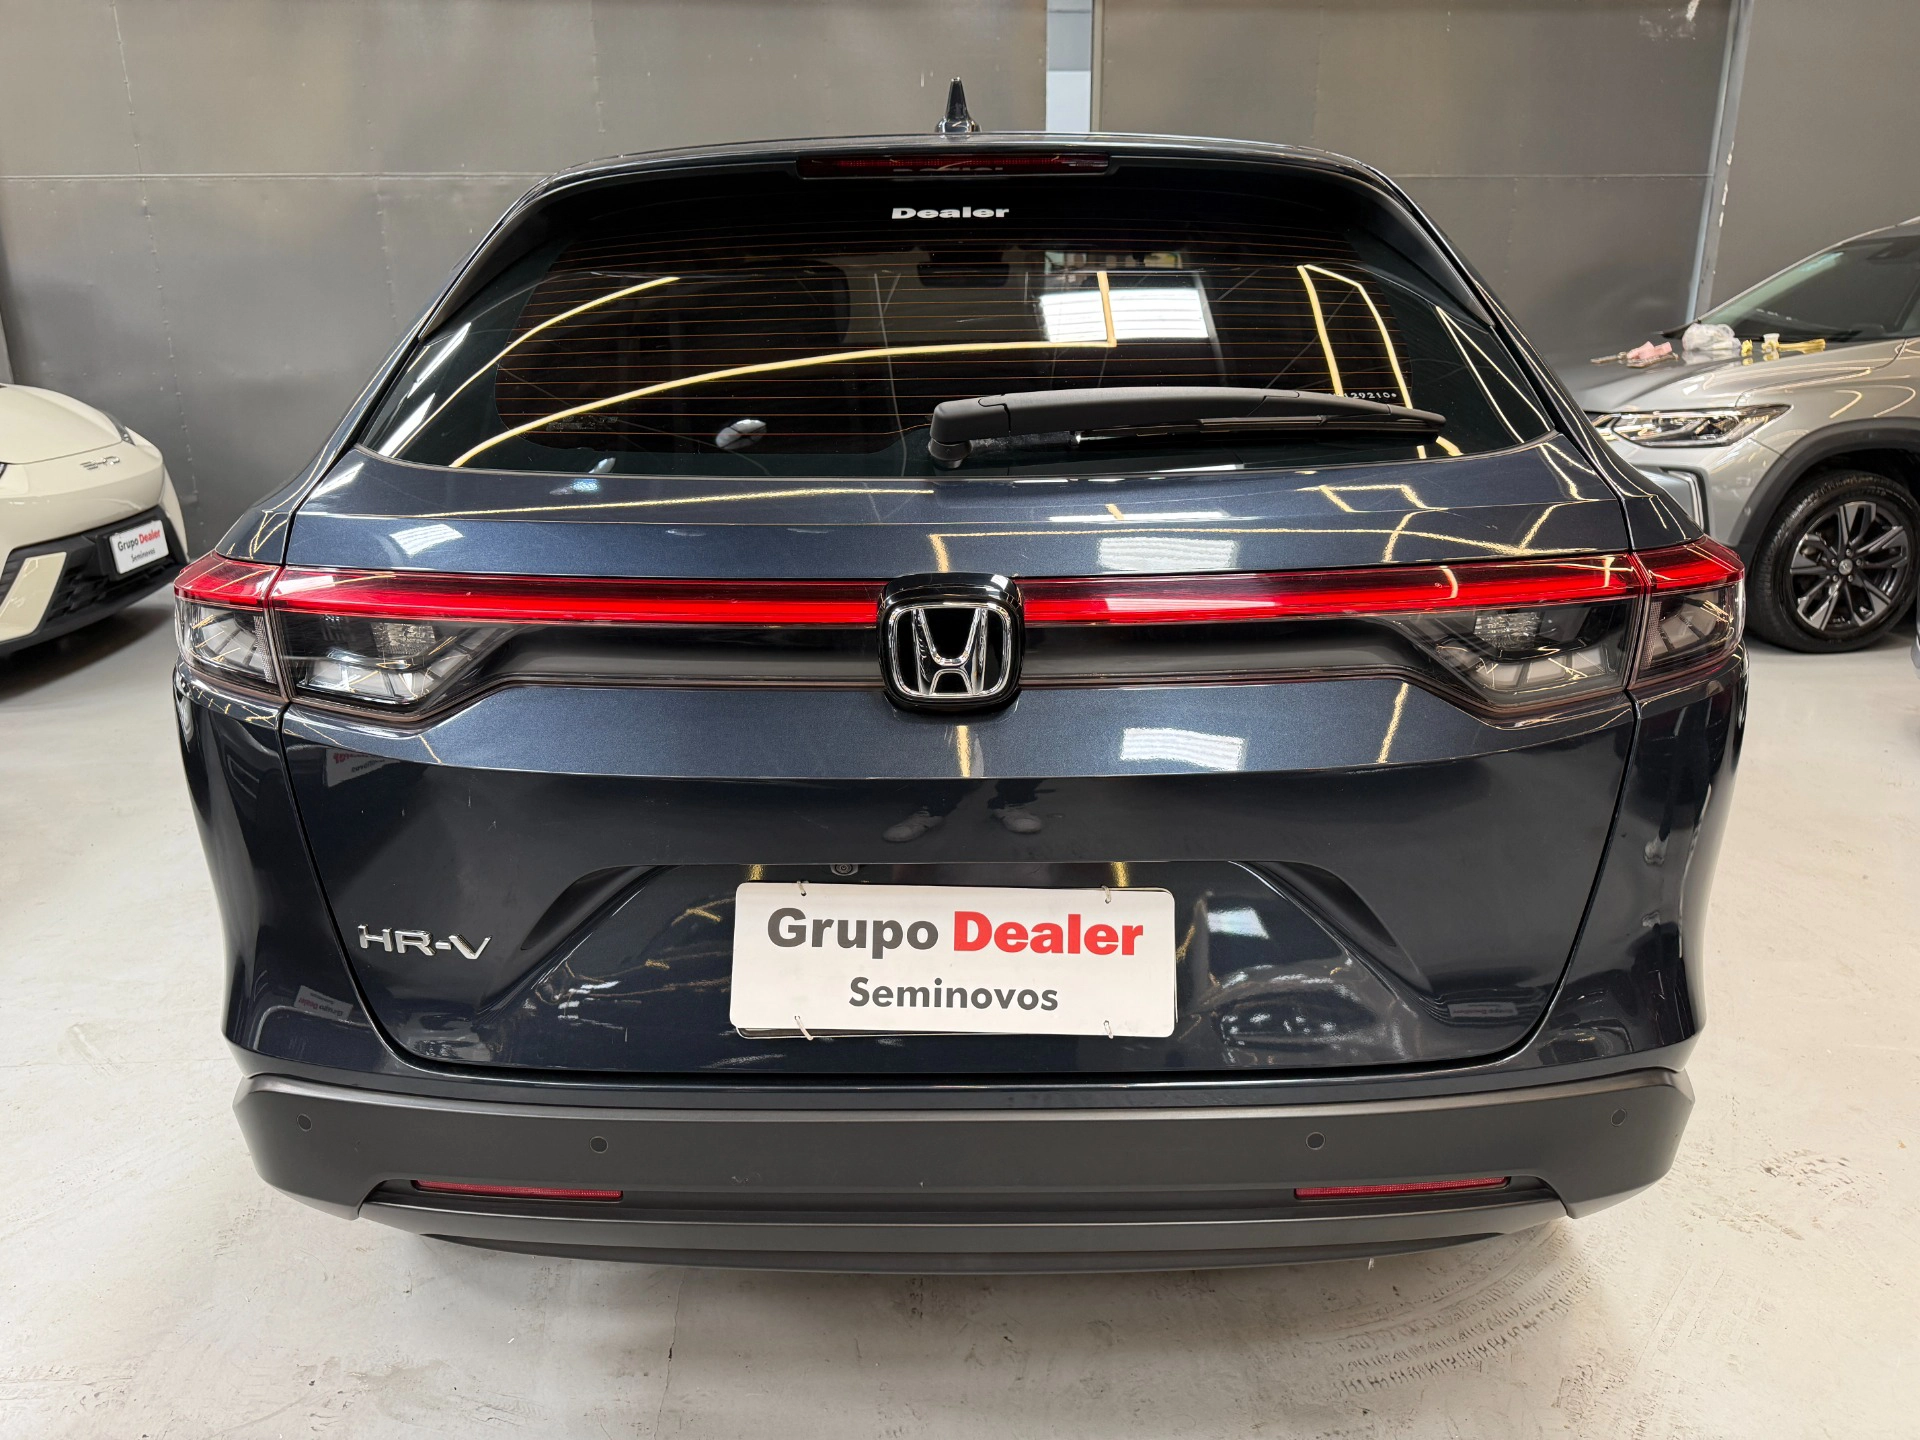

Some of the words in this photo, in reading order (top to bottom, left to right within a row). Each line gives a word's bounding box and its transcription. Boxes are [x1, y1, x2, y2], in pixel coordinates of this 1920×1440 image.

[892, 206, 1010, 219] Dealer
[117, 538, 139, 552] Grupo
[138, 530, 161, 544] Dealer
[358, 924, 492, 960] HR-V
[767, 907, 939, 959] Grupo
[953, 911, 1144, 956] Dealer
[848, 976, 1059, 1012] Seminovos
